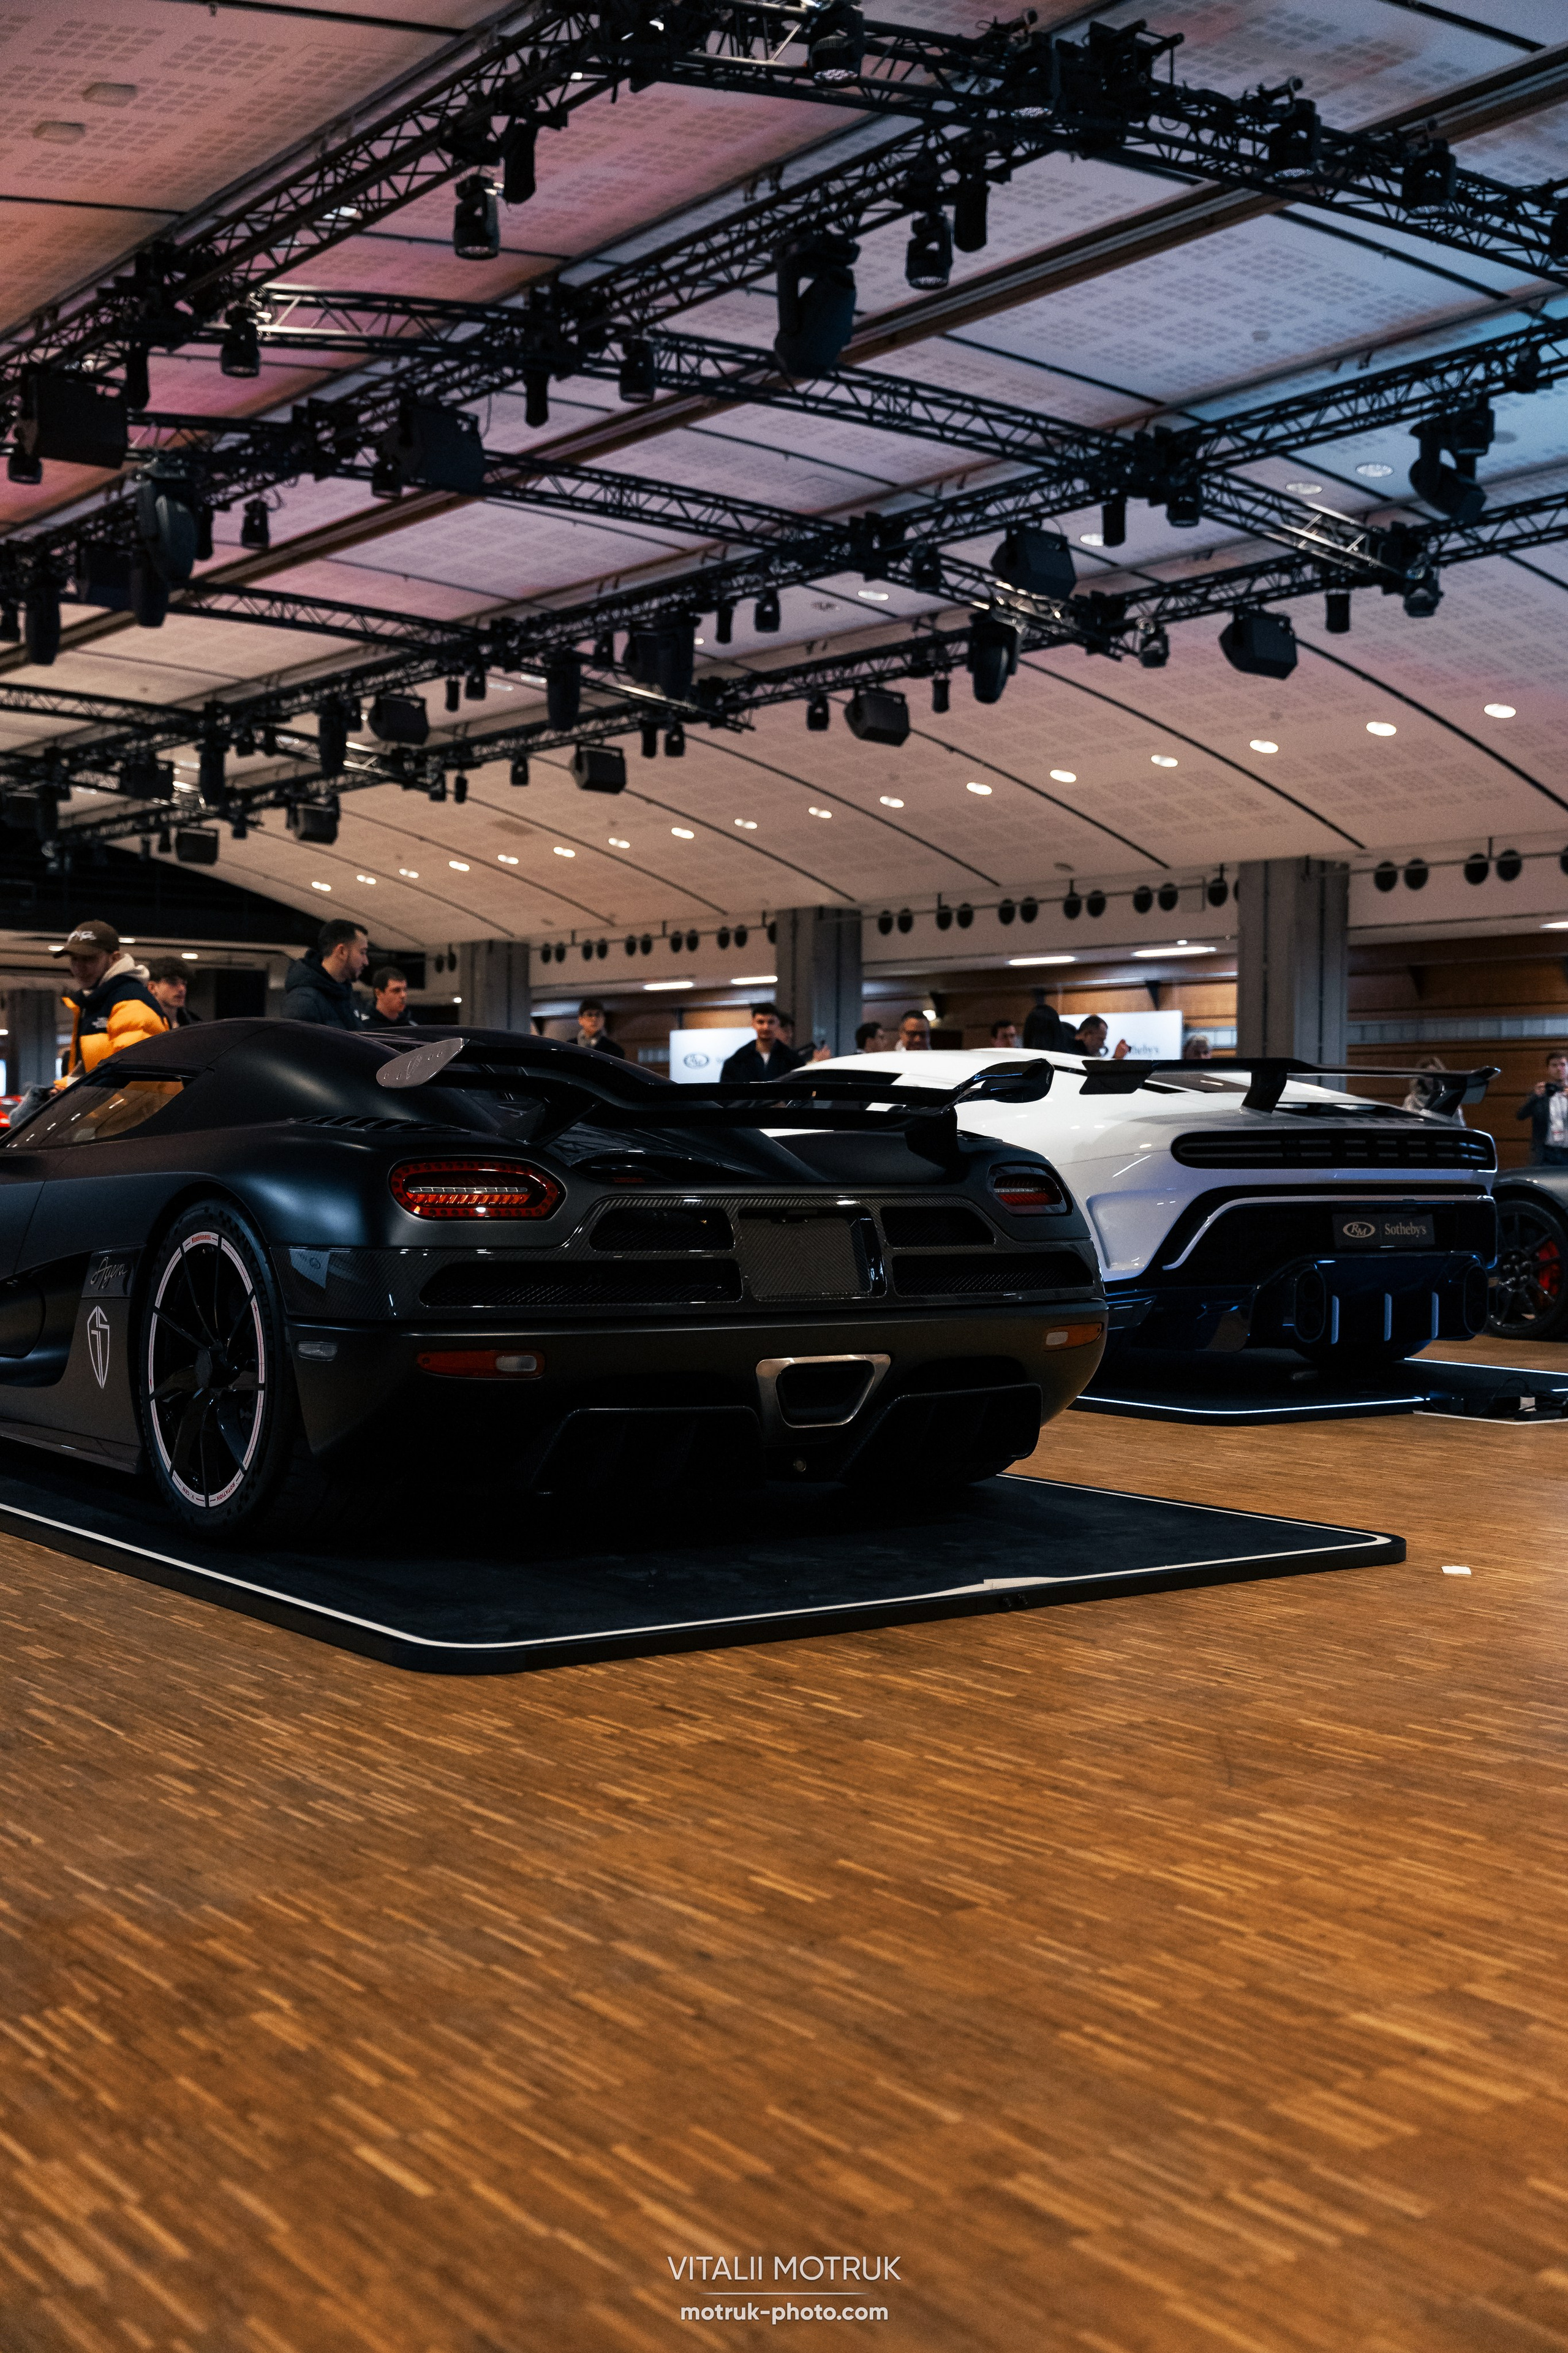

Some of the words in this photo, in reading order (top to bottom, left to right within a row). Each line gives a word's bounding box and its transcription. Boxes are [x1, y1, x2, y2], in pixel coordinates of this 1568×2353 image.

[1385, 1222, 1427, 1237] Sotheby's
[91, 1257, 128, 1290] Agera
[217, 1482, 235, 1501] ROTATION
